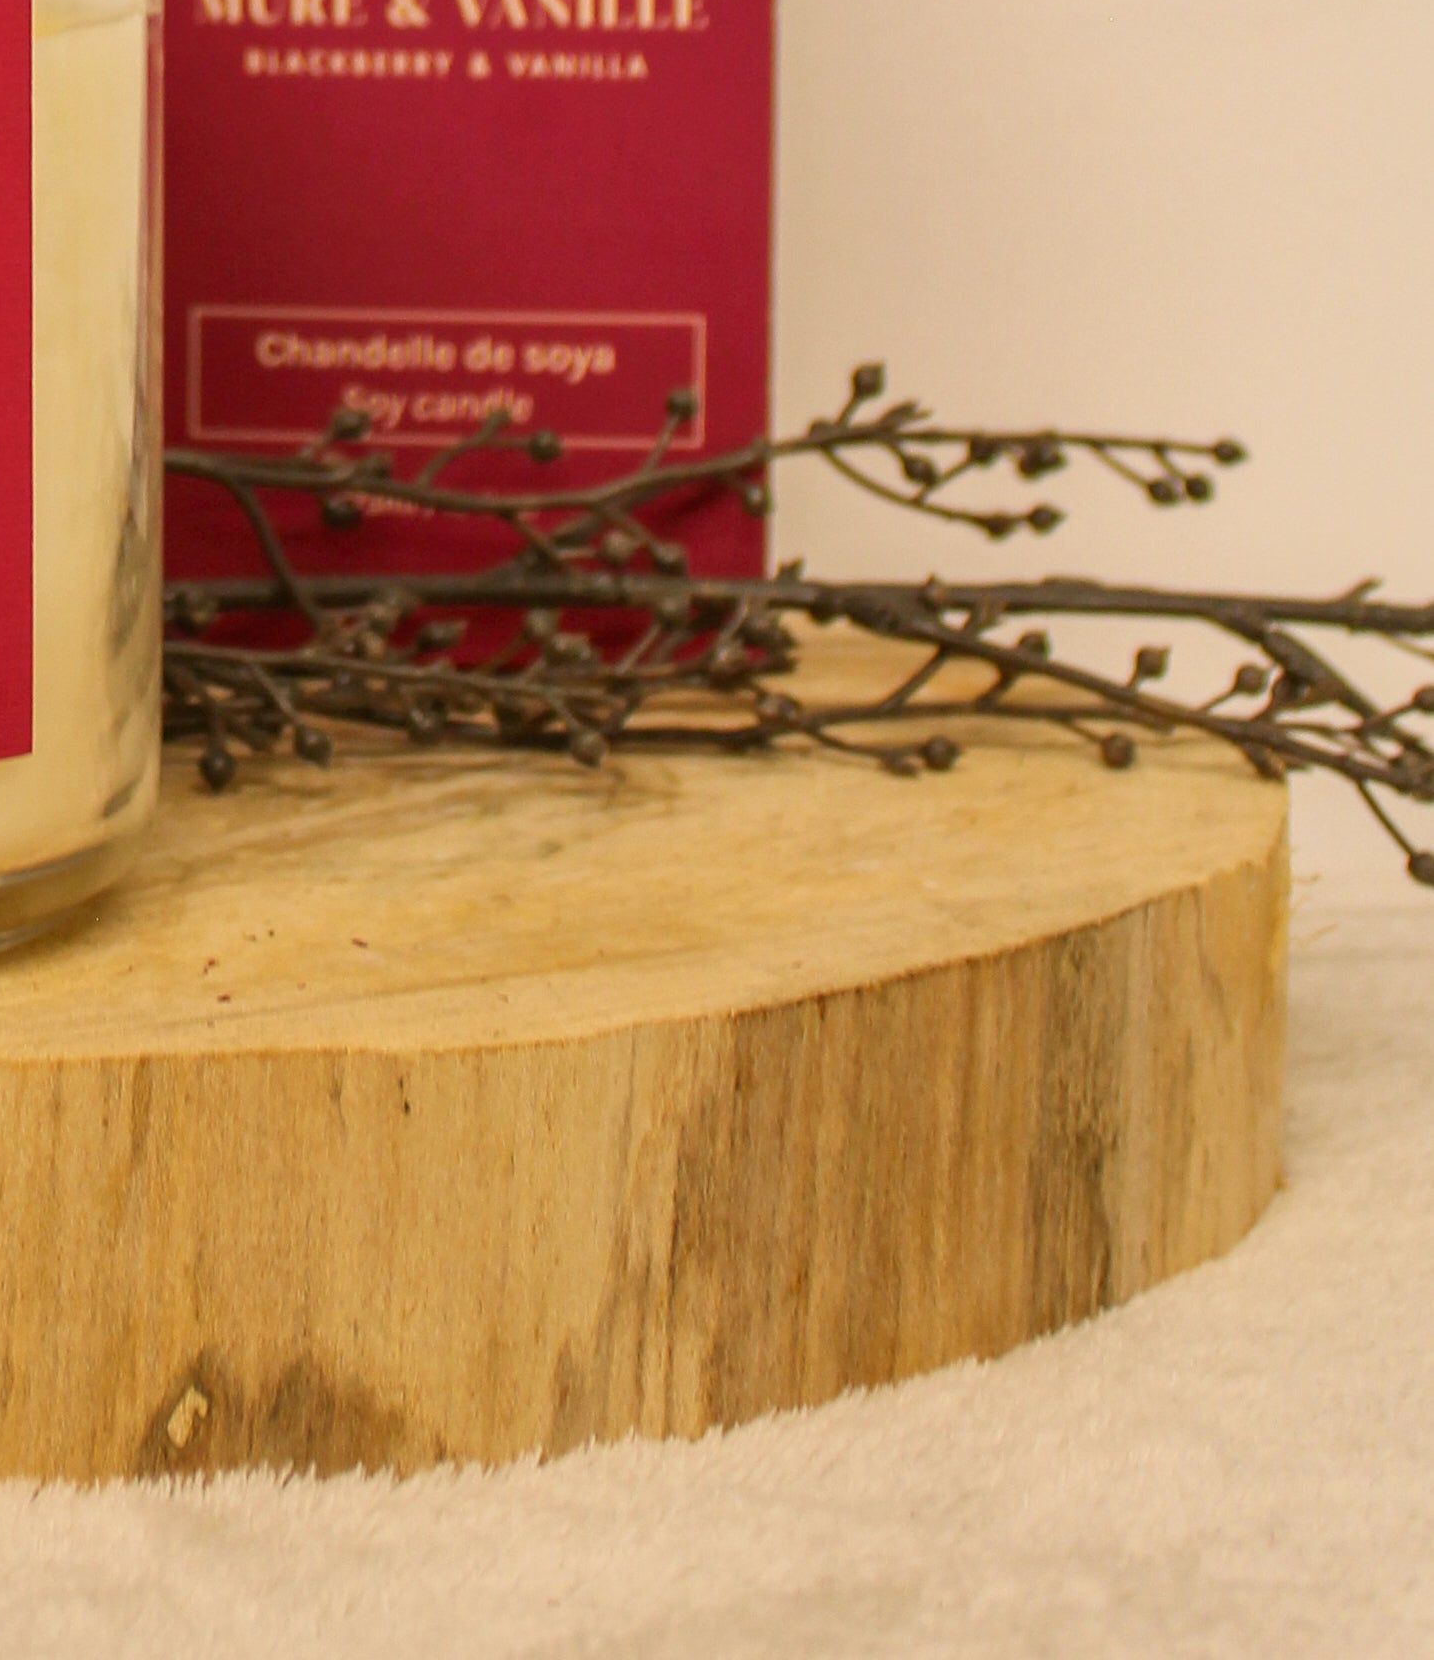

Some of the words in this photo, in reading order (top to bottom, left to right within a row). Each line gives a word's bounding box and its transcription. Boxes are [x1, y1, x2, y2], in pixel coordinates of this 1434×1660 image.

[243, 47, 454, 78] BLACKBERRY
[467, 50, 492, 80] &
[506, 51, 650, 81] VANILLA
[254, 331, 458, 373] Chandelle
[461, 335, 515, 373] de
[522, 341, 617, 385] soya
